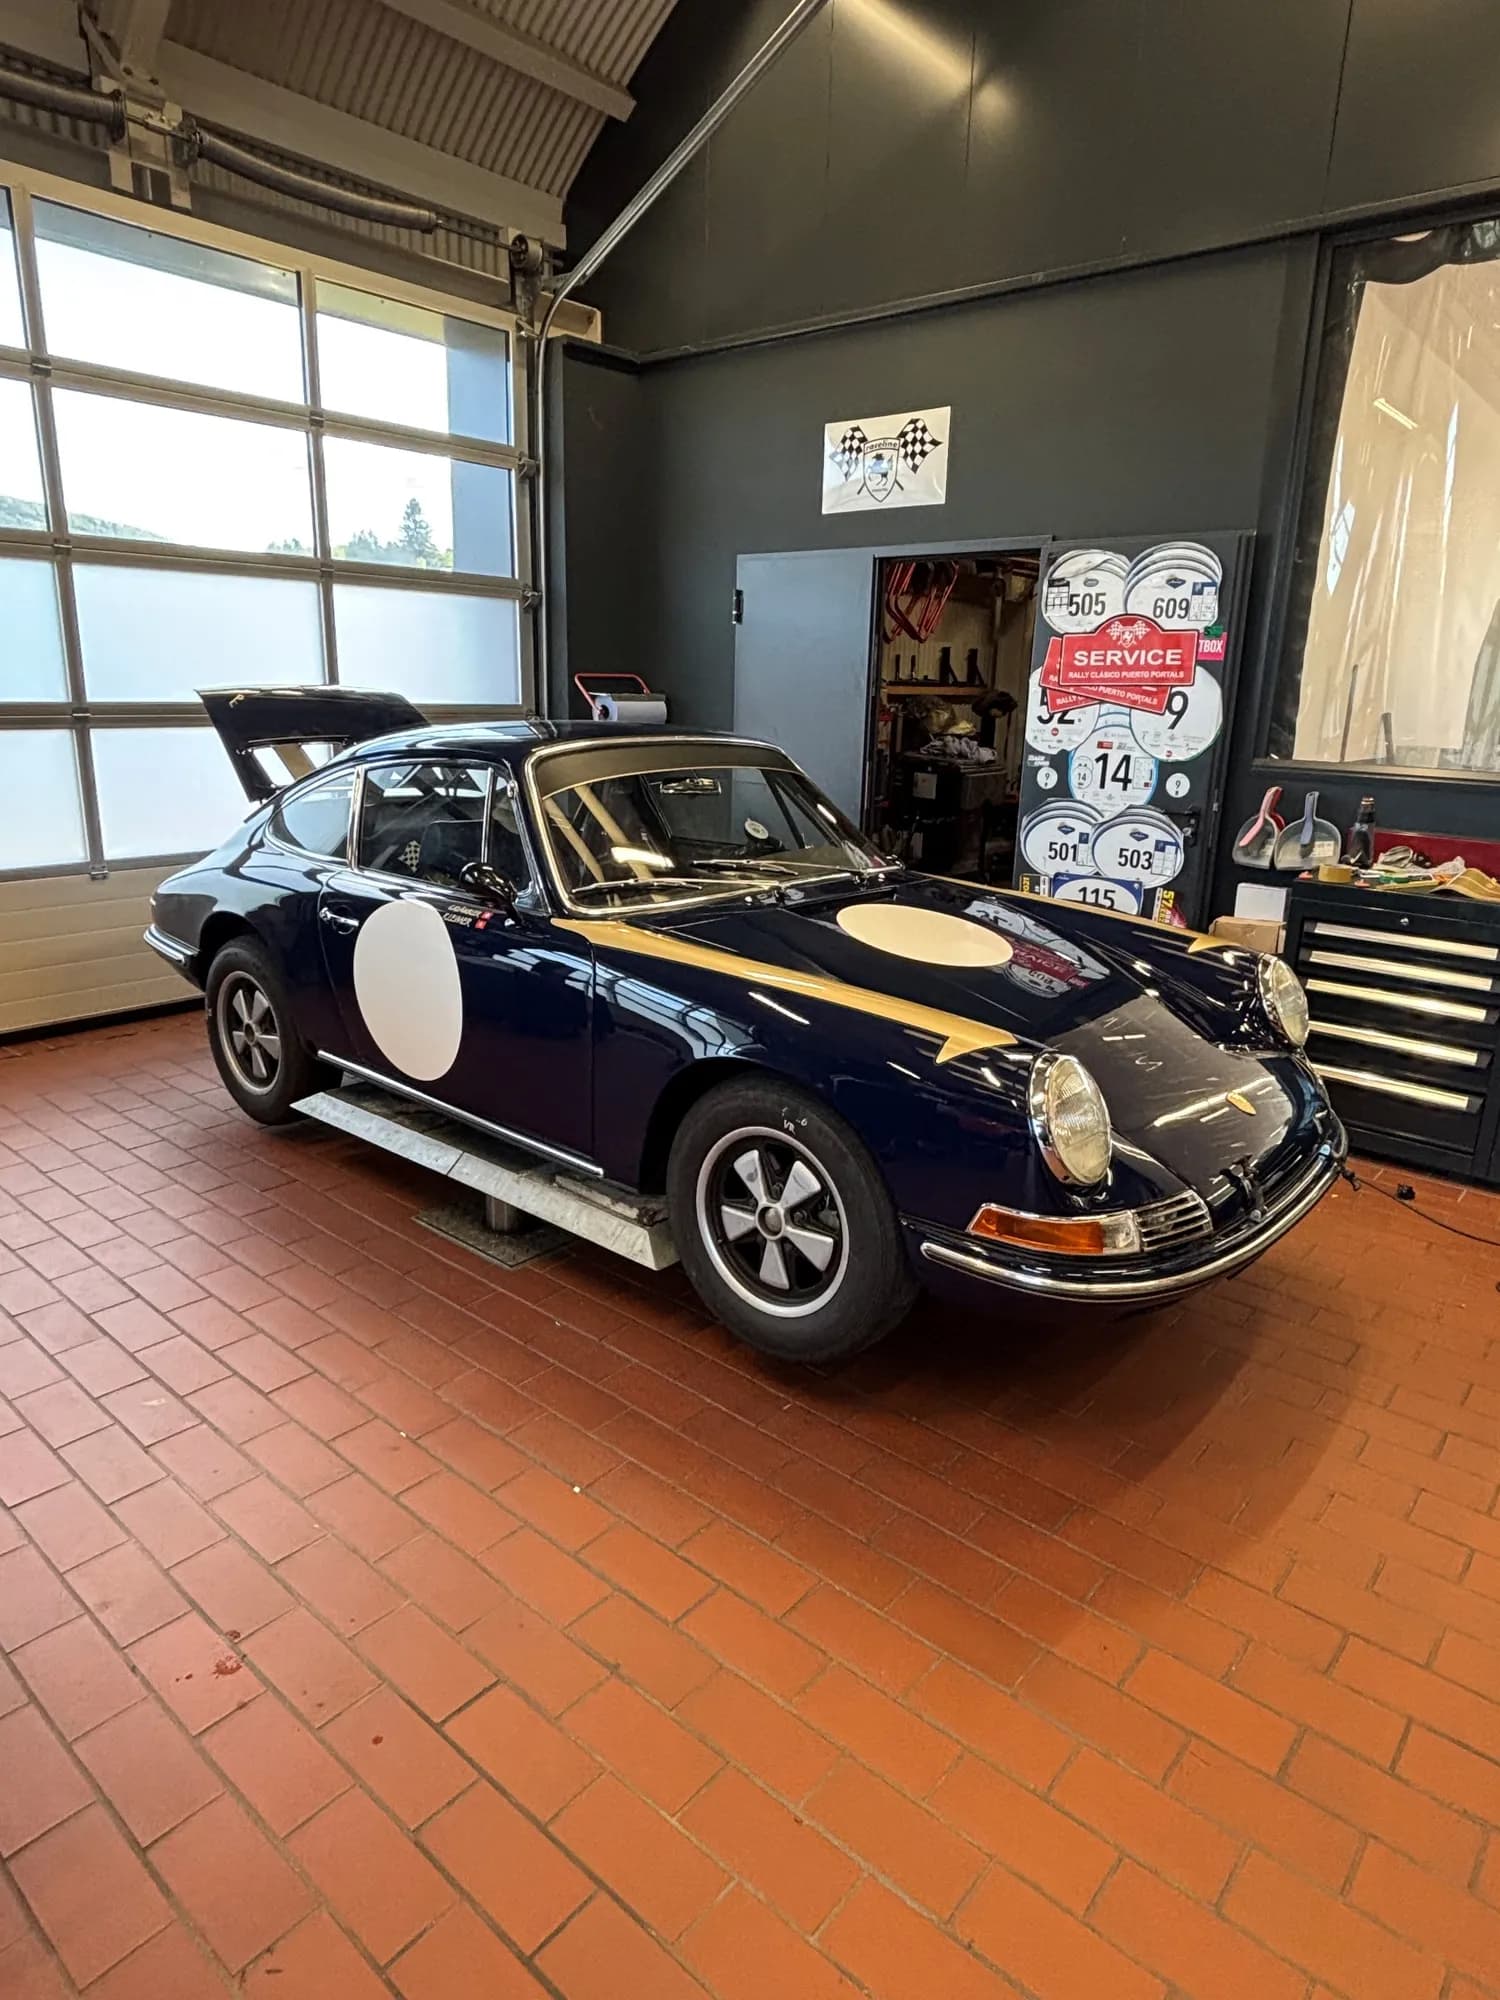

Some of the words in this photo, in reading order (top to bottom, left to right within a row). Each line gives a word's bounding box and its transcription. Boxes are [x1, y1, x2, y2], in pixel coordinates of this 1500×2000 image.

[1069, 592, 1106, 616] 505
[1153, 598, 1190, 619] 609
[1073, 649, 1182, 666] SERVICE
[1121, 671, 1148, 679] PUERTO
[1098, 686, 1126, 698] PUERTO
[1167, 691, 1189, 730] 9
[1095, 753, 1132, 791] 14
[1048, 842, 1078, 862] 501
[1118, 848, 1153, 870] 503
[1078, 886, 1116, 910] 115
